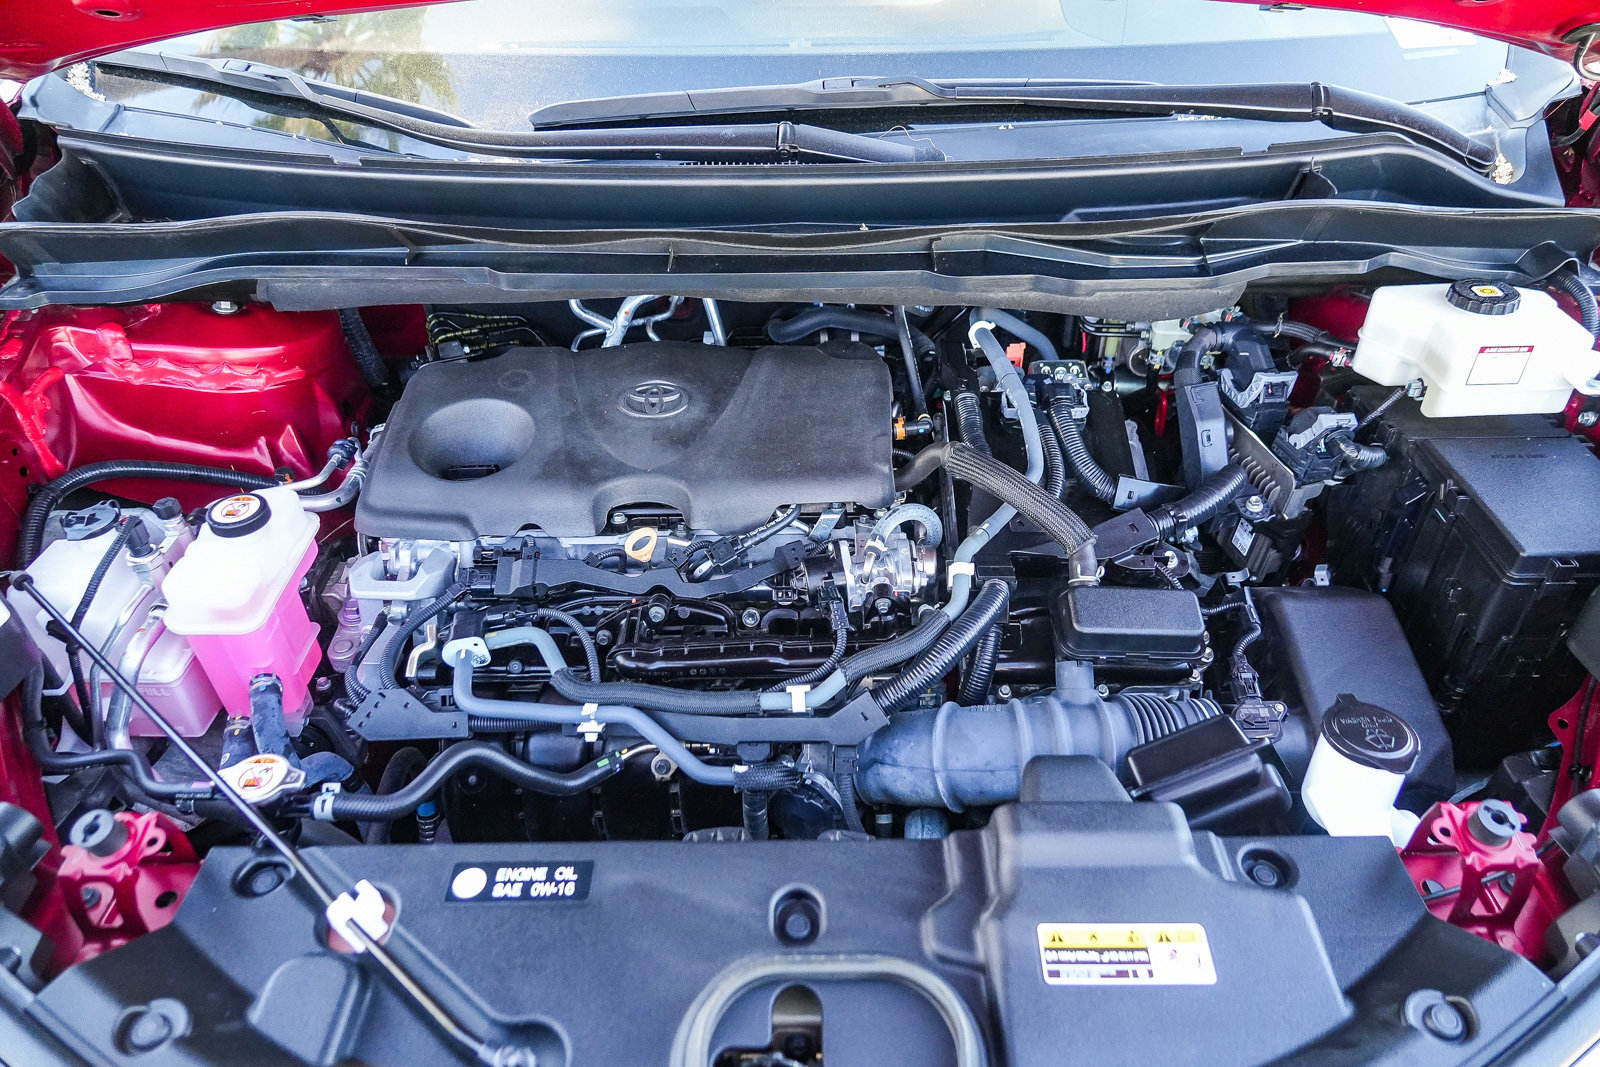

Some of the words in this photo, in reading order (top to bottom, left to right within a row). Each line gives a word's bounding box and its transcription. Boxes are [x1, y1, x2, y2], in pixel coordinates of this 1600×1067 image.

[495, 867, 548, 882] ENGINE
[554, 866, 578, 881] OIL
[491, 882, 523, 898] SAE
[530, 881, 576, 897] 0W-16
